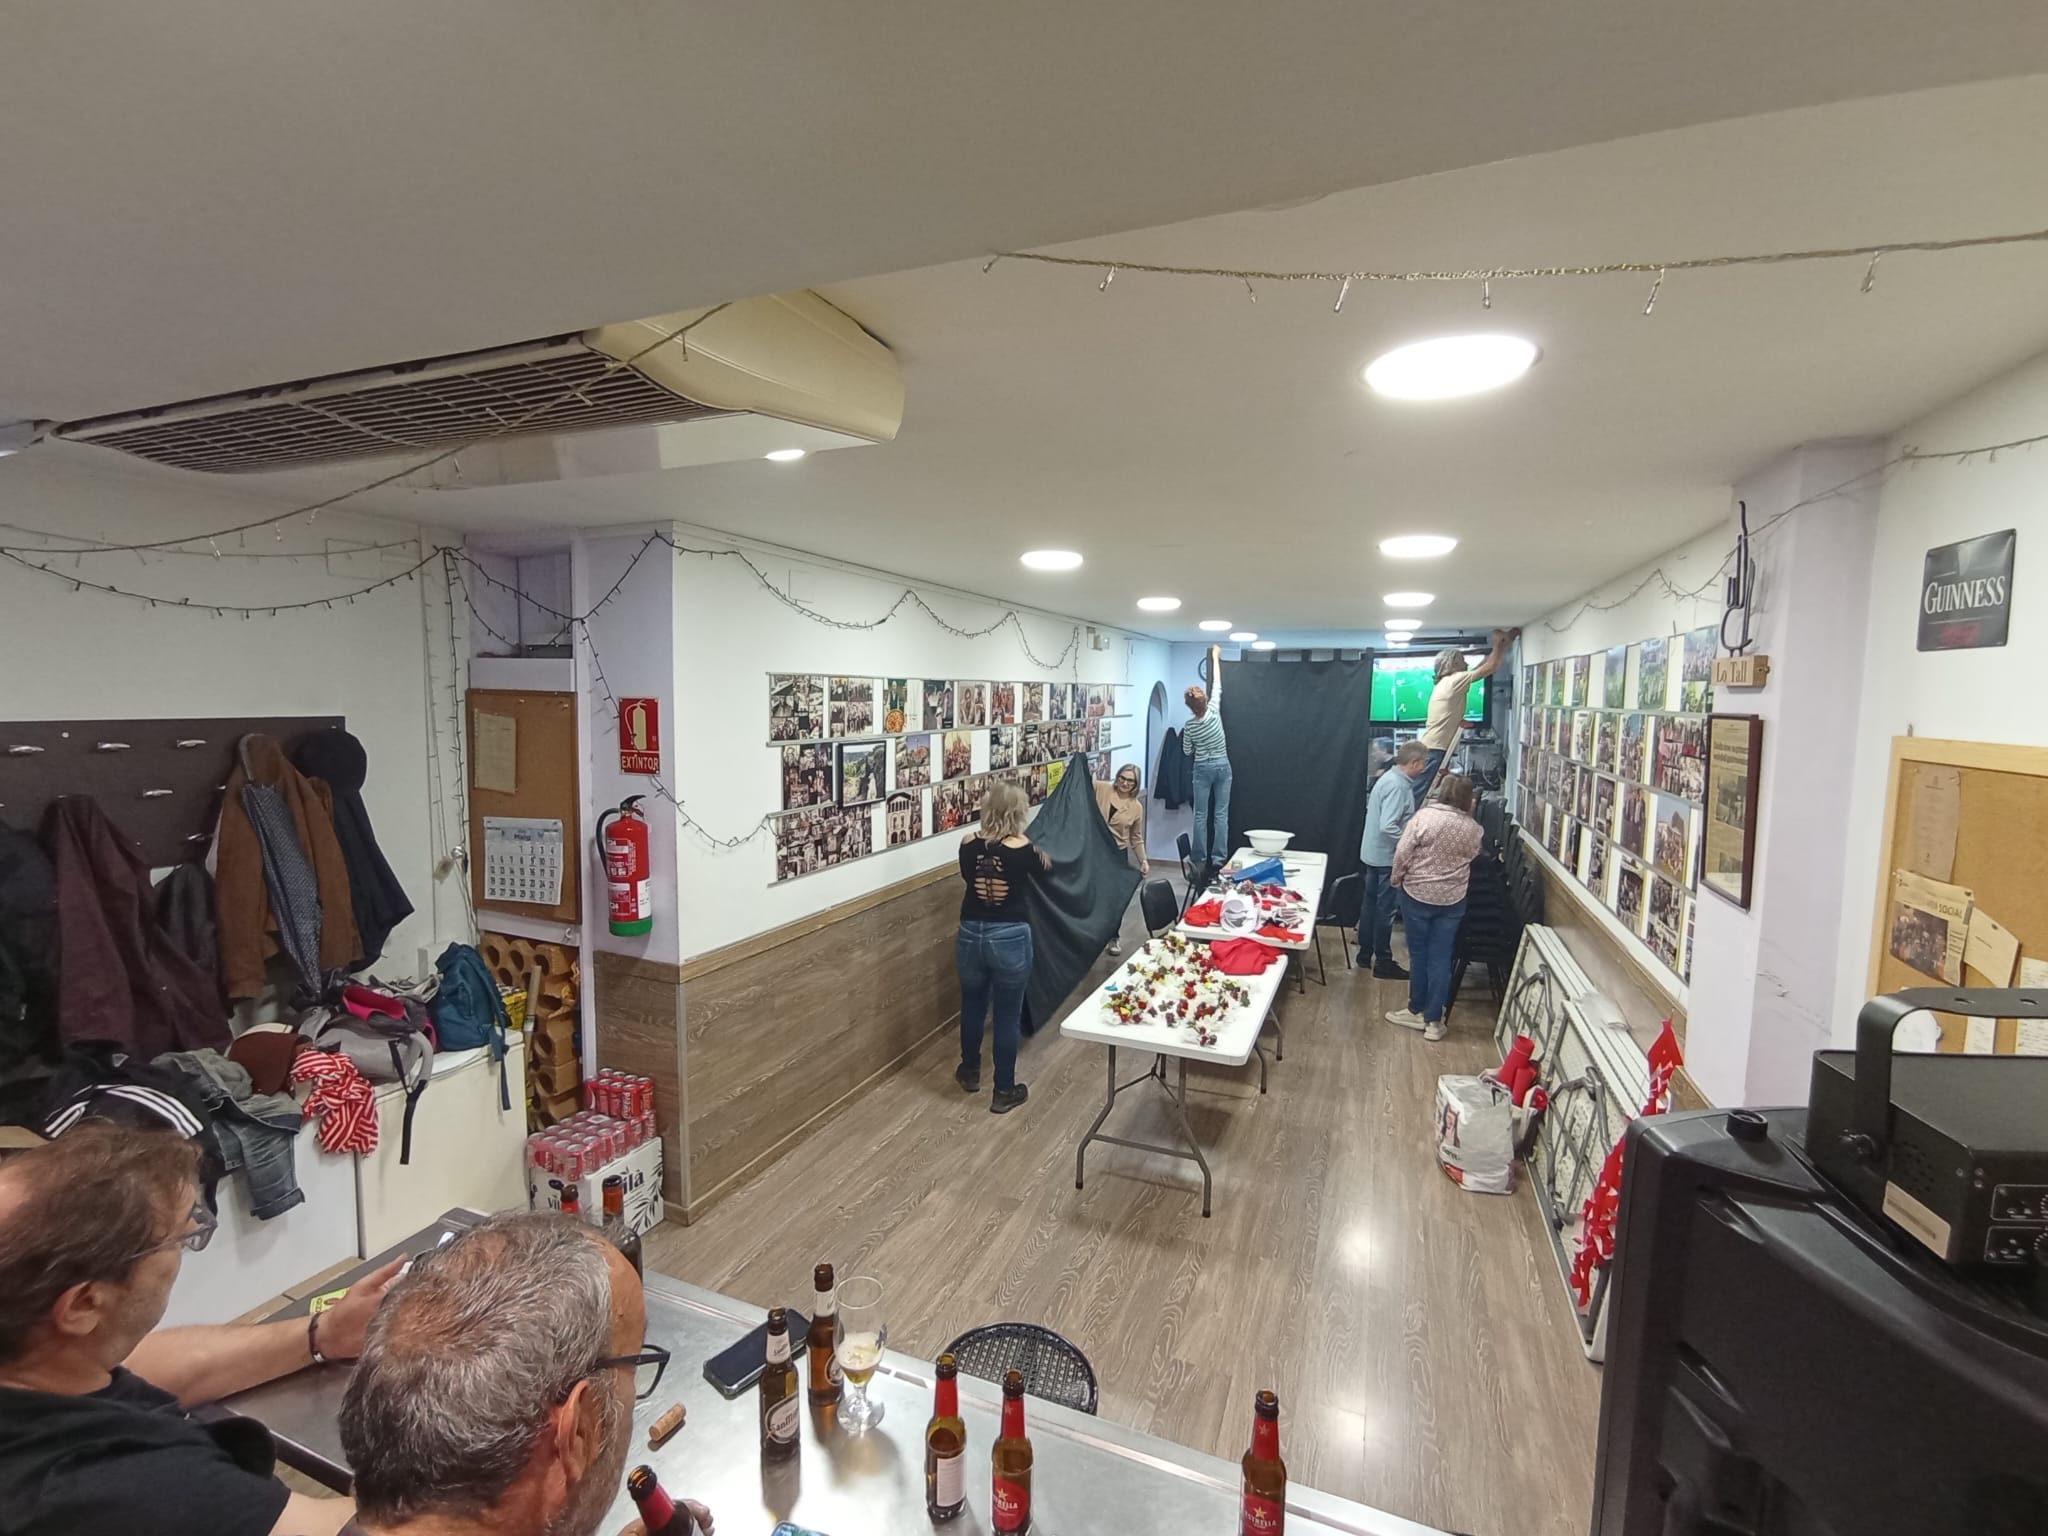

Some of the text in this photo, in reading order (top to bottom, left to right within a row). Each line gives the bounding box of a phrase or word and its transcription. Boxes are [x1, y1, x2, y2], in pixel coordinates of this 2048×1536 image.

[1924, 575, 2006, 614] GUINNESS
[1716, 660, 1748, 683] Lo Tall
[621, 756, 659, 769] EXTINTOR
[621, 1167, 644, 1195] ilà
